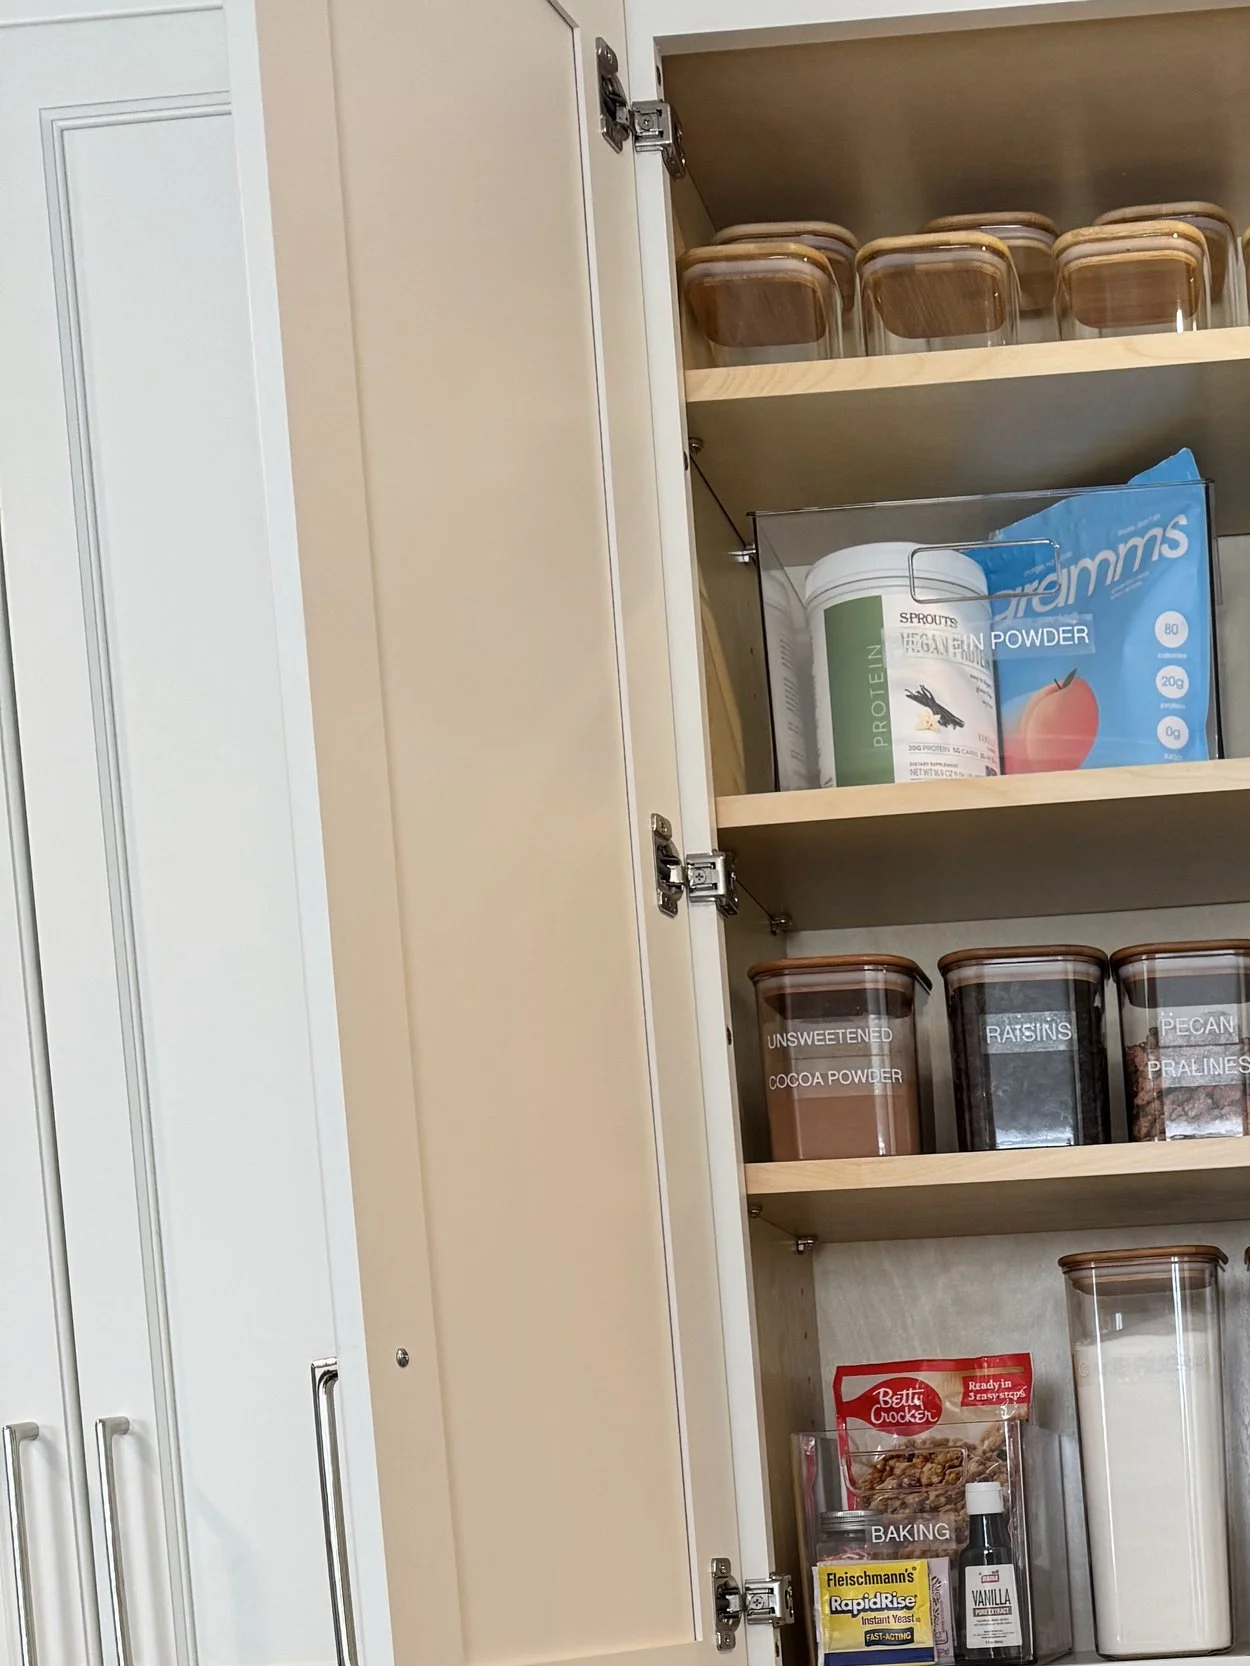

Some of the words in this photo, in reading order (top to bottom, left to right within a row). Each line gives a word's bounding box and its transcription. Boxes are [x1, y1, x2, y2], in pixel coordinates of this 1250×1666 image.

[900, 612, 958, 629] SPROUTS
[1164, 623, 1178, 635] 80
[990, 625, 1089, 650] POWDER
[1161, 675, 1184, 689] 20g
[868, 643, 889, 749] PROTEIN
[1165, 726, 1181, 740] 0g
[986, 1021, 1072, 1044] RAISINS
[1161, 1015, 1234, 1038] PECAN
[767, 1027, 893, 1050] UNSWEETENED
[768, 1071, 825, 1091] COCOA
[827, 1067, 903, 1086] POWDER
[968, 1379, 999, 1392] Ready
[1001, 1379, 1012, 1389] in
[872, 1386, 925, 1412] Betty
[976, 1392, 999, 1402] easy
[870, 1405, 938, 1425] Crocker
[871, 1522, 951, 1544] BAKING
[826, 1567, 915, 1588] Fleischmann's
[830, 1592, 917, 1617] RapidRise
[972, 1588, 1012, 1607] VANILLA
[861, 1614, 891, 1626] Instant
[893, 1612, 916, 1625] Yeast
[864, 1630, 913, 1643] FAST-ACTING
